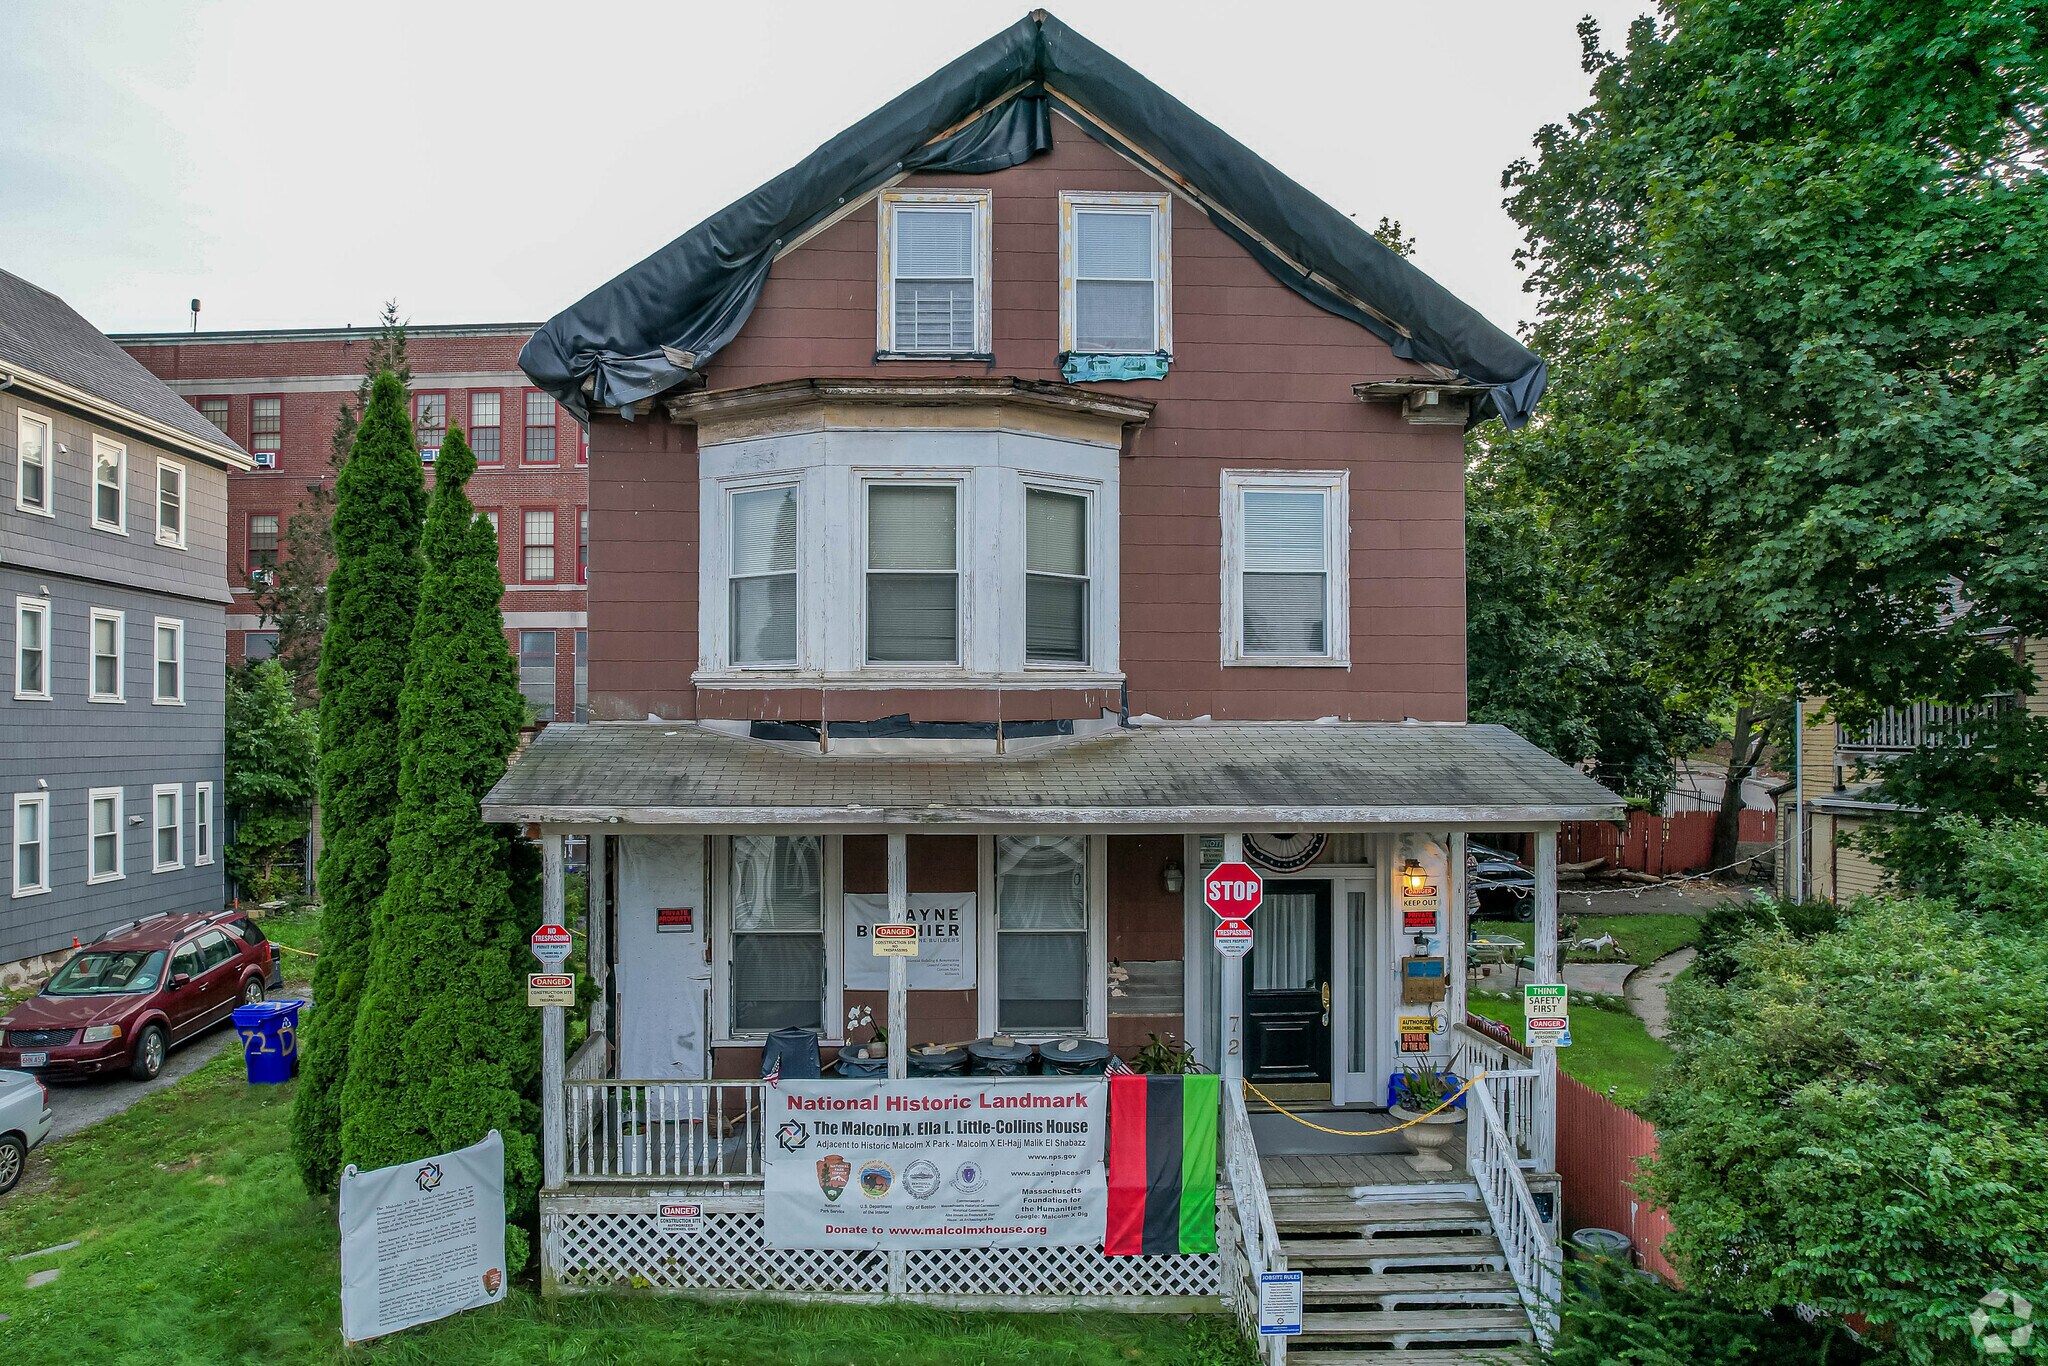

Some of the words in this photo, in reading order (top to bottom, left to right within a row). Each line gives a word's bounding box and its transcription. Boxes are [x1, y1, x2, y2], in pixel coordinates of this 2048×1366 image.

[1209, 881, 1258, 901] STOP
[906, 909, 959, 921] AYNE
[1533, 987, 1558, 995] THINK
[1529, 997, 1562, 1005] SAFETY
[1534, 1005, 1557, 1013] FIRST
[242, 1030, 276, 1053] 72
[277, 1027, 295, 1057] D
[1402, 1042, 1408, 1050] OF
[1409, 1042, 1418, 1050] THE
[1419, 1042, 1429, 1050] DOG
[787, 1095, 878, 1111] National
[886, 1094, 972, 1111] Historic
[979, 1093, 1088, 1108] Landmark
[814, 1121, 838, 1135] The
[842, 1121, 899, 1137] Malcolm
[902, 1122, 914, 1136] X.
[917, 1121, 941, 1135] Ella
[944, 1120, 954, 1134] L.
[957, 1119, 1044, 1134] Little-Collins
[1046, 1119, 1088, 1134] House
[816, 1140, 850, 1149] Adjacent
[851, 1141, 859, 1149] to
[861, 1141, 891, 1149] Historic
[892, 1140, 924, 1149] Malcolm
[925, 1140, 931, 1148] X
[932, 1140, 950, 1148] Park
[956, 1139, 988, 1148] Malcolm
[990, 1139, 996, 1147] X
[997, 1139, 1022, 1149] El-Hajj
[1023, 1139, 1043, 1147] Malik
[1045, 1139, 1053, 1147] El
[1054, 1139, 1086, 1147] Shabazz
[1011, 1169, 1091, 1177] www.savingplaces.org
[1022, 1187, 1082, 1195] Massachusetts
[664, 1207, 697, 1215] DANGER
[825, 1225, 868, 1234] Donate
[872, 1225, 884, 1234] to
[889, 1225, 1047, 1235] www.malcolmxhouse.org
